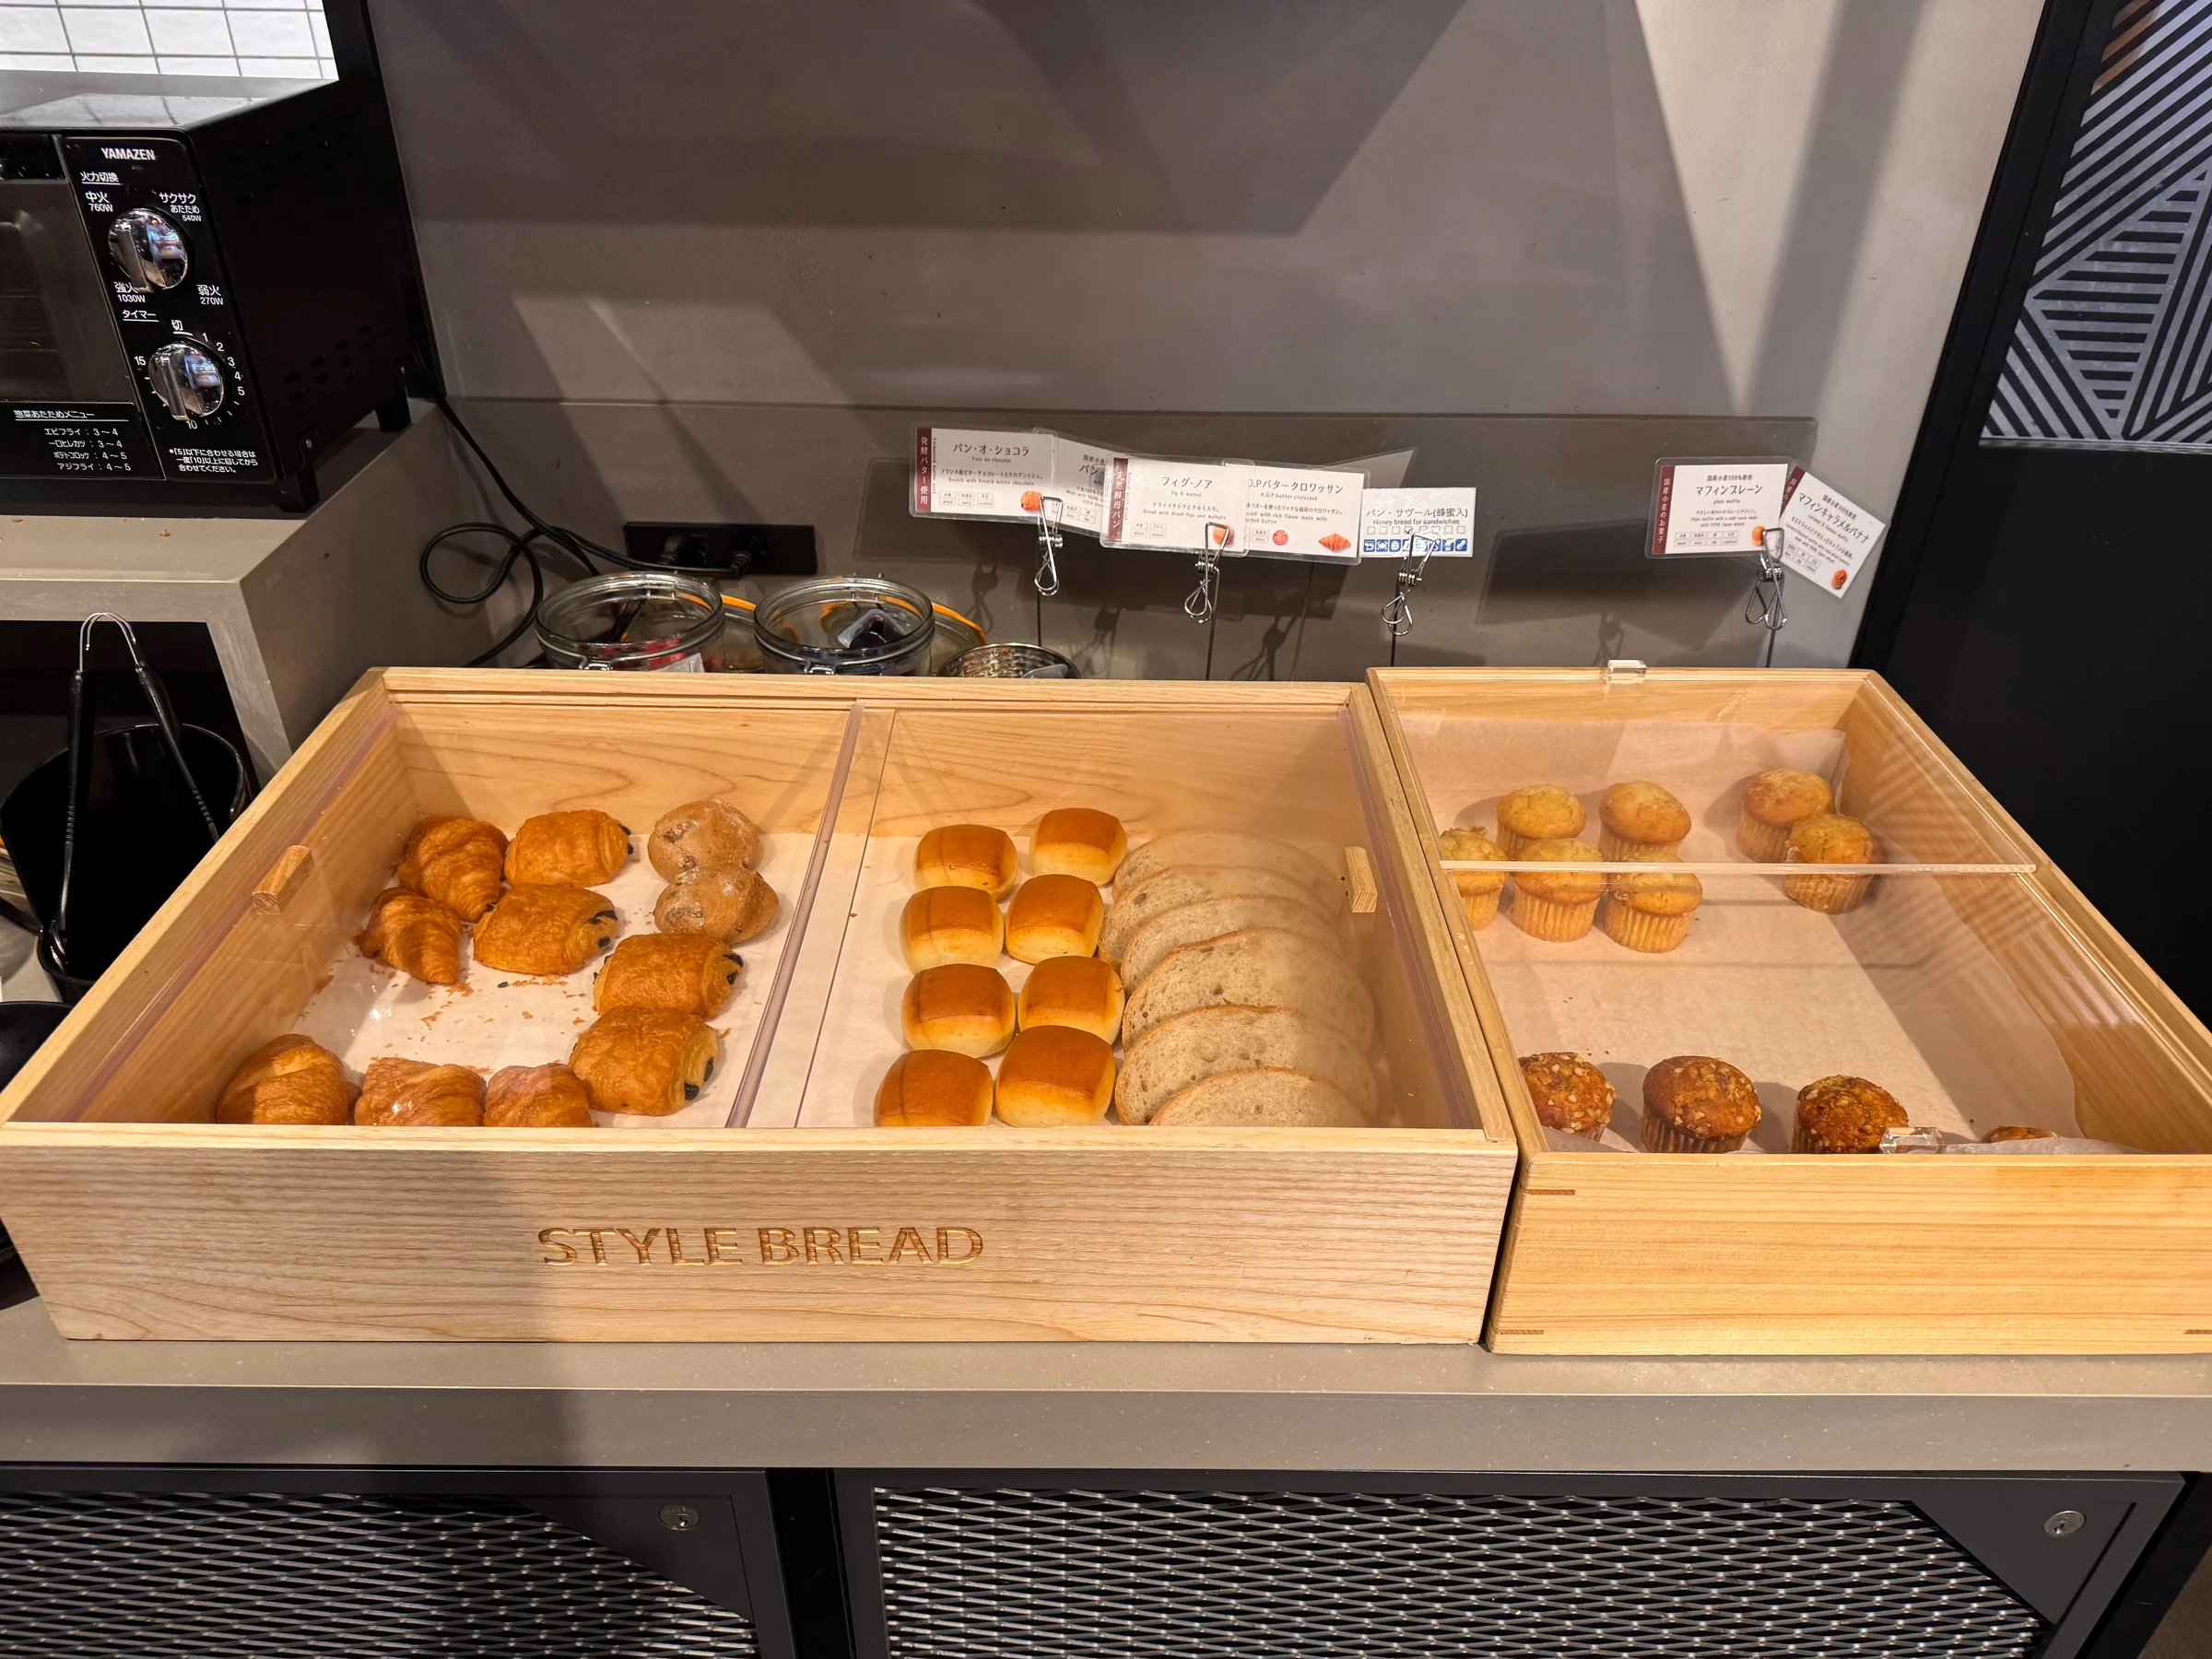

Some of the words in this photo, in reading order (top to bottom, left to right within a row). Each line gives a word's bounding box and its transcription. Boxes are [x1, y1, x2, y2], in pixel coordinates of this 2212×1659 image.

[101, 147, 156, 160] YAMAZEN
[80, 171, 120, 182] 火力切換
[86, 192, 110, 204] 中火
[159, 193, 196, 204] サクサク
[88, 204, 113, 212] 760W
[170, 205, 200, 214] あたため
[114, 282, 138, 293] 強火
[197, 285, 221, 295] 弱火
[117, 294, 145, 303] 1030W
[200, 297, 223, 305] 270W
[123, 311, 156, 319] タイマー
[172, 320, 183, 331] 切
[202, 333, 207, 342] 1
[217, 343, 224, 352] 2
[135, 356, 146, 366] 15
[228, 357, 235, 367] 3
[234, 371, 241, 381] 4
[238, 387, 245, 396] 5
[186, 420, 197, 429] 10
[953, 443, 1030, 457] パン・オ・ショコラ
[1162, 477, 1213, 489] フィグ・ノア
[1696, 485, 1763, 496] マフィンプレーン
[1799, 493, 1869, 543] マフィンキャラメルバナナ
[538, 1227, 743, 1266] STYLE
[758, 1227, 983, 1265] BREAD
